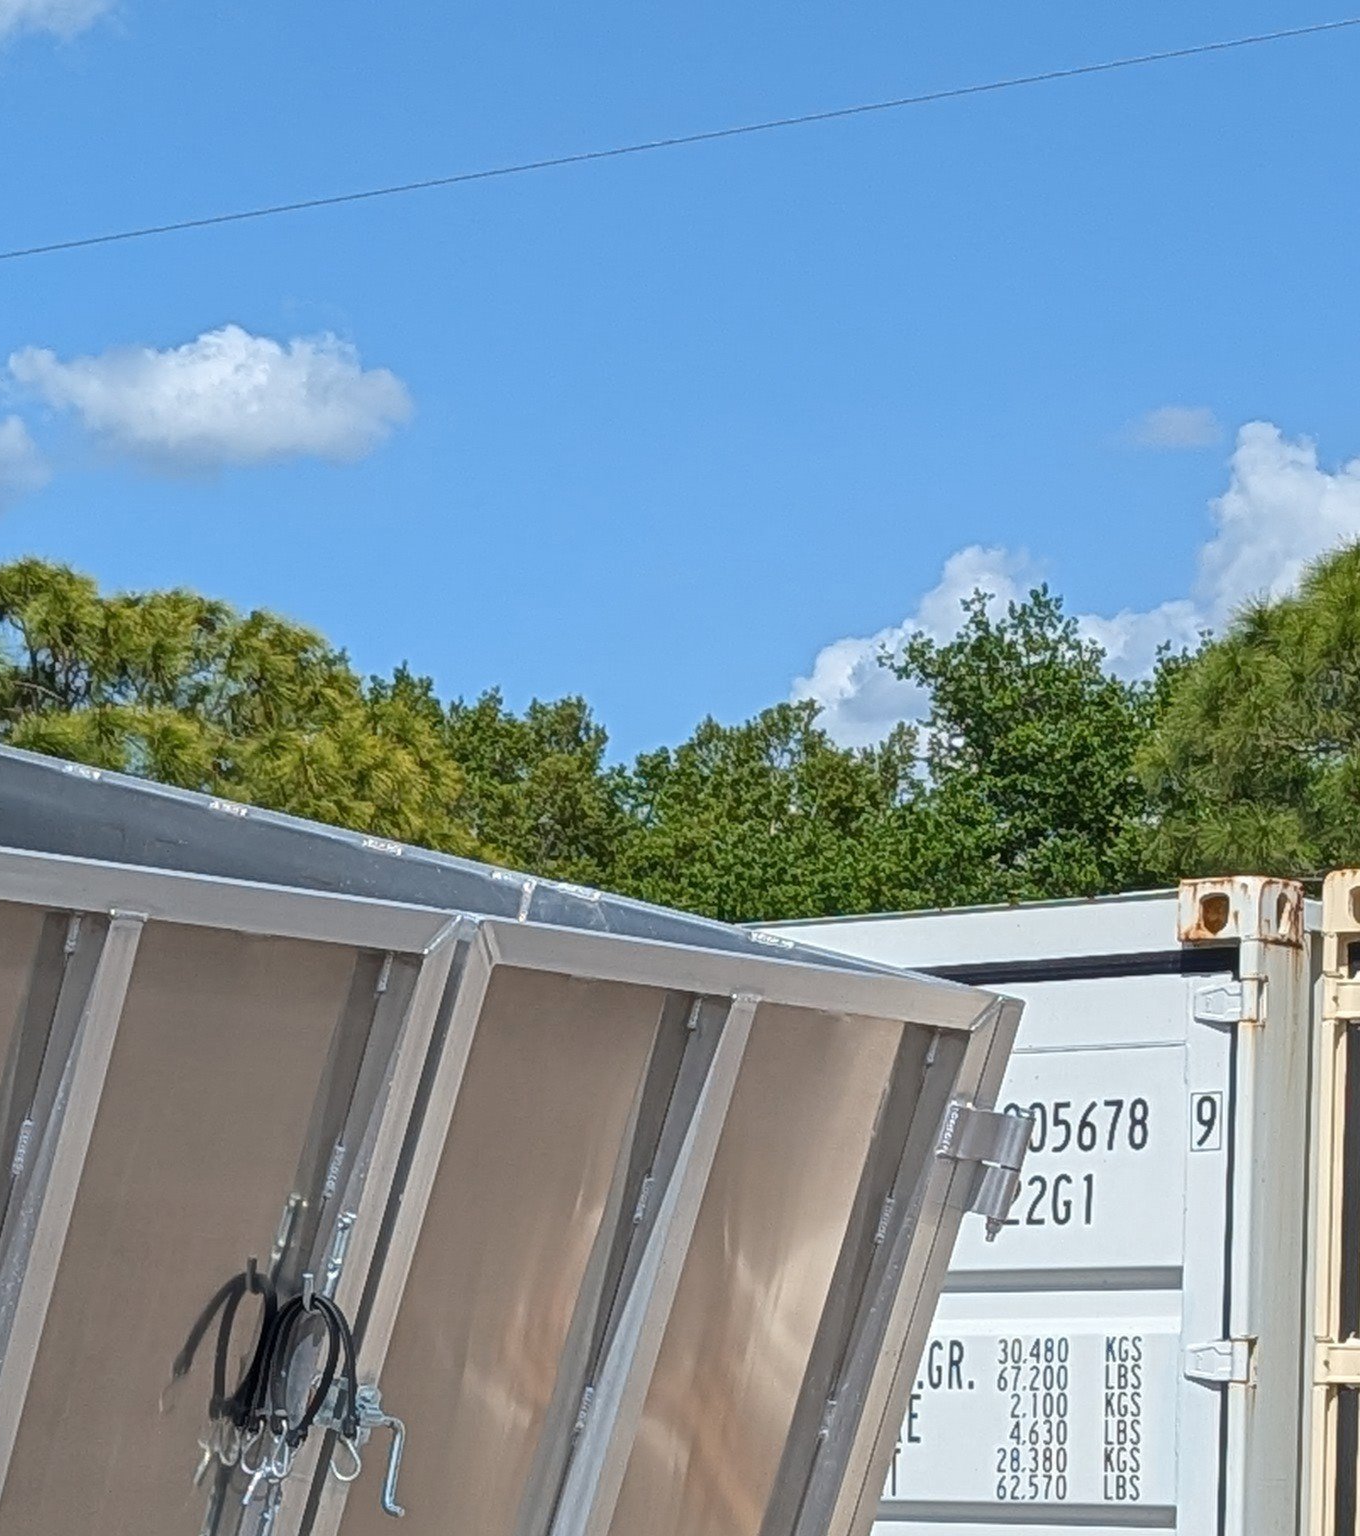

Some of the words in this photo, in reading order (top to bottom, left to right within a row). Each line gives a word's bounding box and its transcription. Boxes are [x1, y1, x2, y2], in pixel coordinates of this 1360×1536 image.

[1004, 1098, 1149, 1152] 05678
[1197, 1095, 1217, 1147] 9
[1105, 1336, 1142, 1362] KGS
[1105, 1364, 1142, 1390] LBS
[1105, 1392, 1141, 1418] KGS
[1104, 1419, 1141, 1445] LBS
[1104, 1447, 1140, 1473] KGS
[1104, 1474, 1140, 1500] LBS
